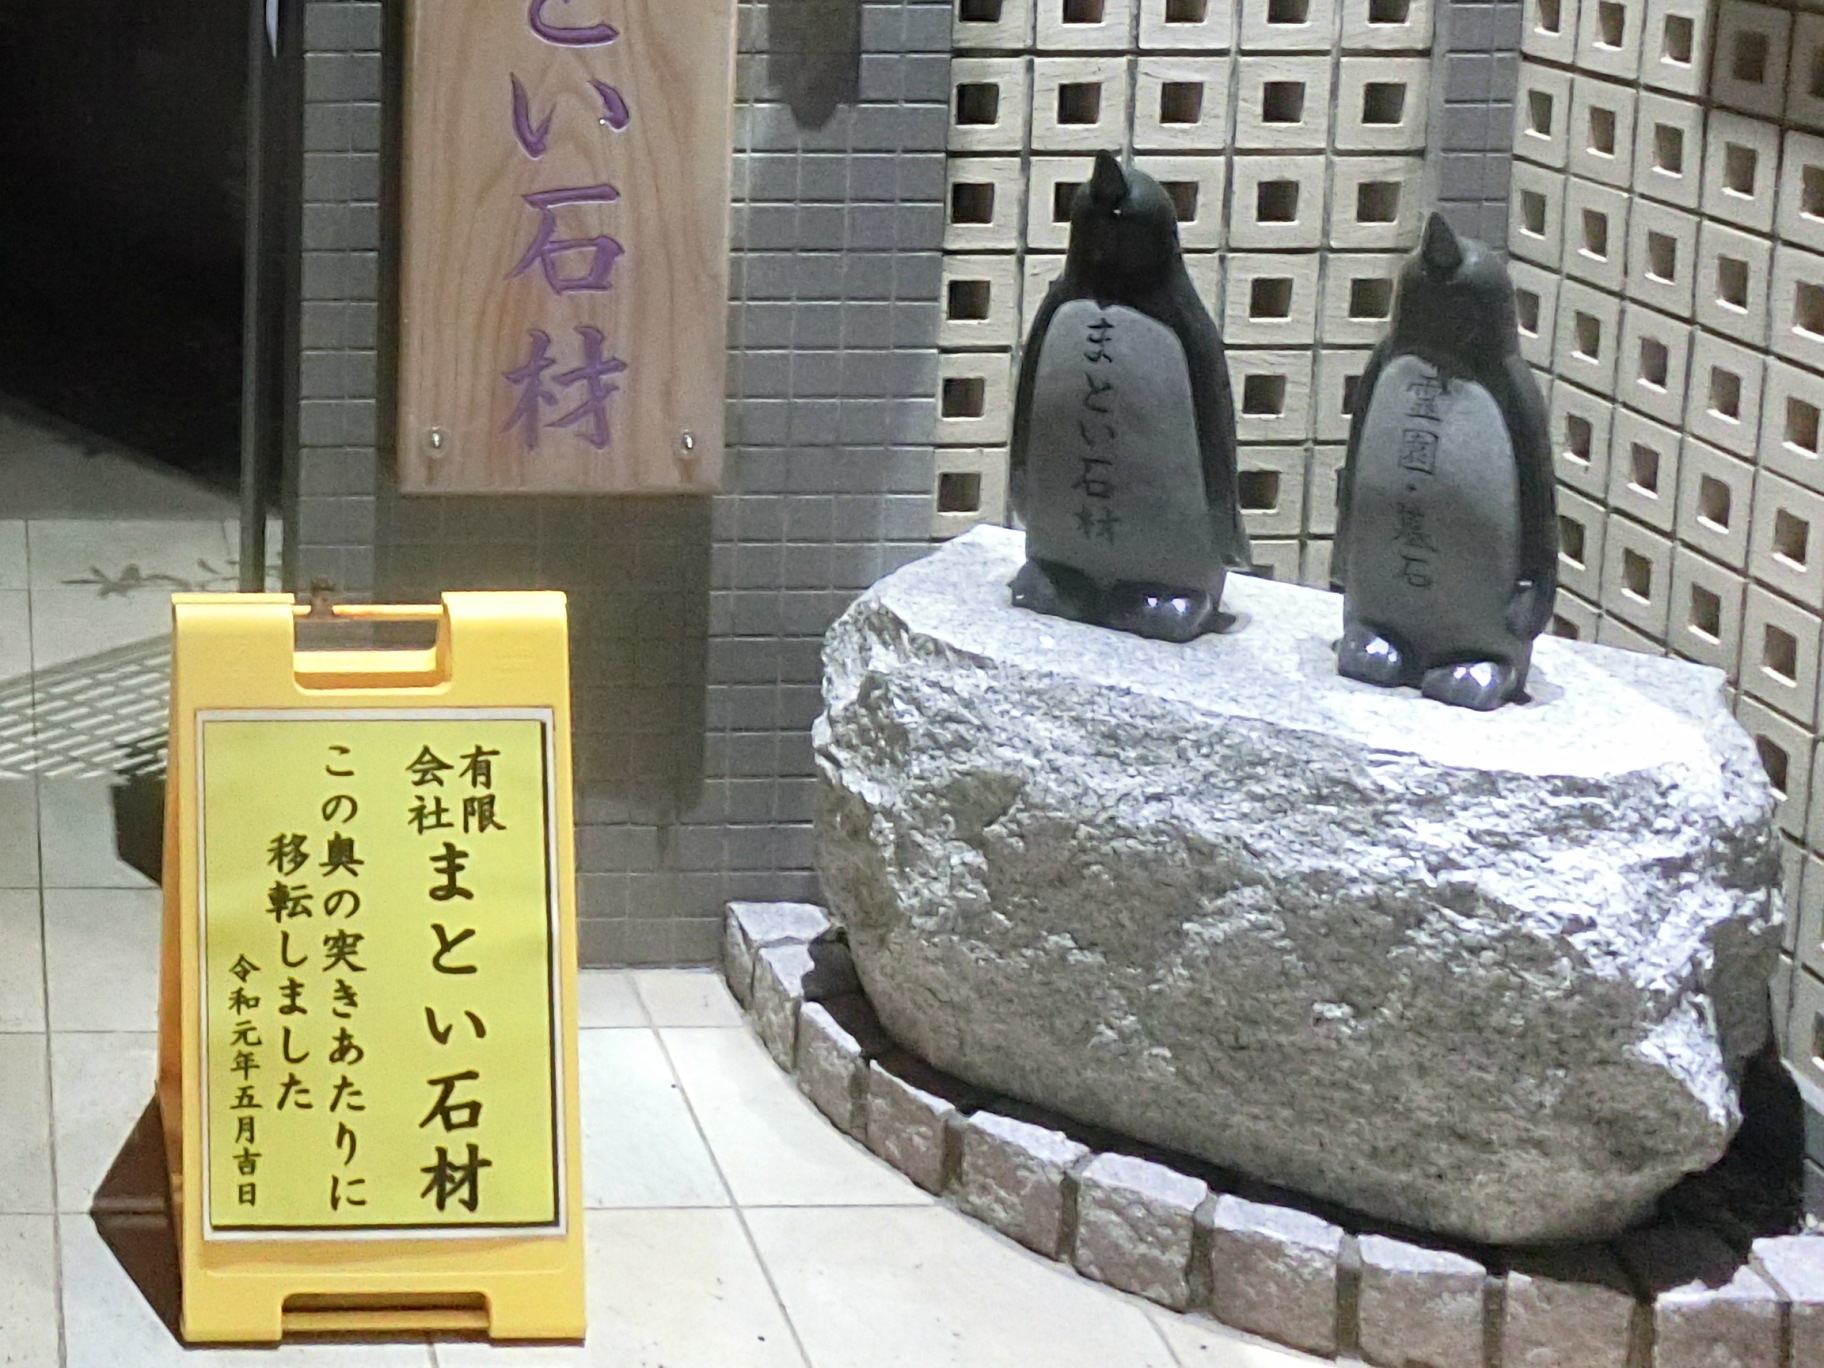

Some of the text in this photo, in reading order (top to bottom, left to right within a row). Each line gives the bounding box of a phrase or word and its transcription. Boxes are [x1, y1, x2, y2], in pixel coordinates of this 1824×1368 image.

[405, 744, 454, 833] 会社
[458, 744, 506, 833] 有限
[228, 954, 262, 1207] 令和元年五月吉日
[265, 833, 314, 1112] 移転しました
[319, 745, 367, 1211] この奥の突きあたりに
[419, 841, 492, 1213] まとい石材
